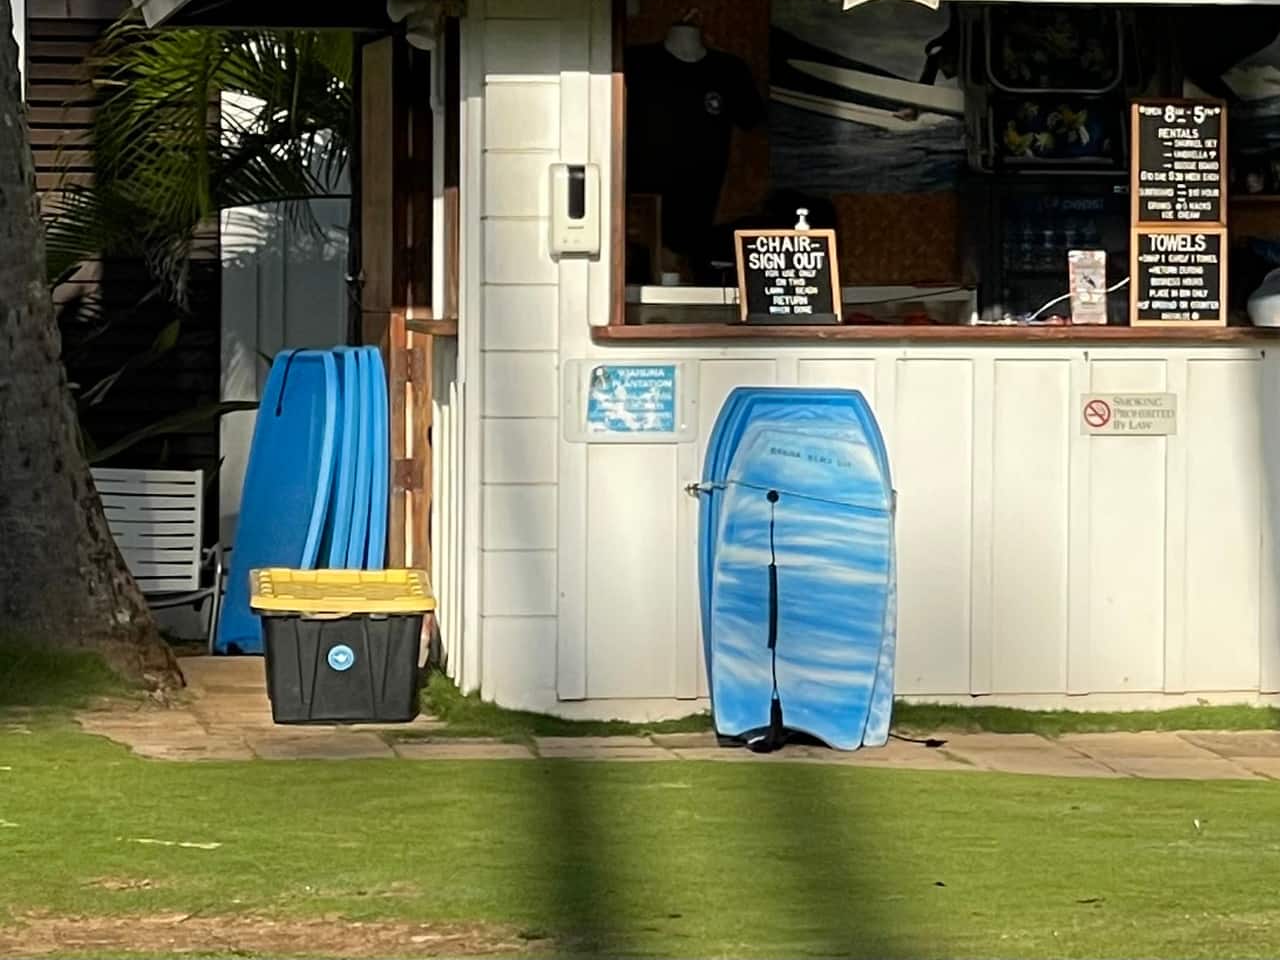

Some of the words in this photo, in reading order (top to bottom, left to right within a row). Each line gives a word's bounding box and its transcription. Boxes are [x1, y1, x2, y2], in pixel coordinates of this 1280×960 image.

[1158, 128, 1200, 138] RENTALS
[1148, 234, 1207, 252] TOWELS
[749, 252, 785, 270] SIGN
[793, 252, 825, 270] OUT
[773, 295, 808, 306] RETURN
